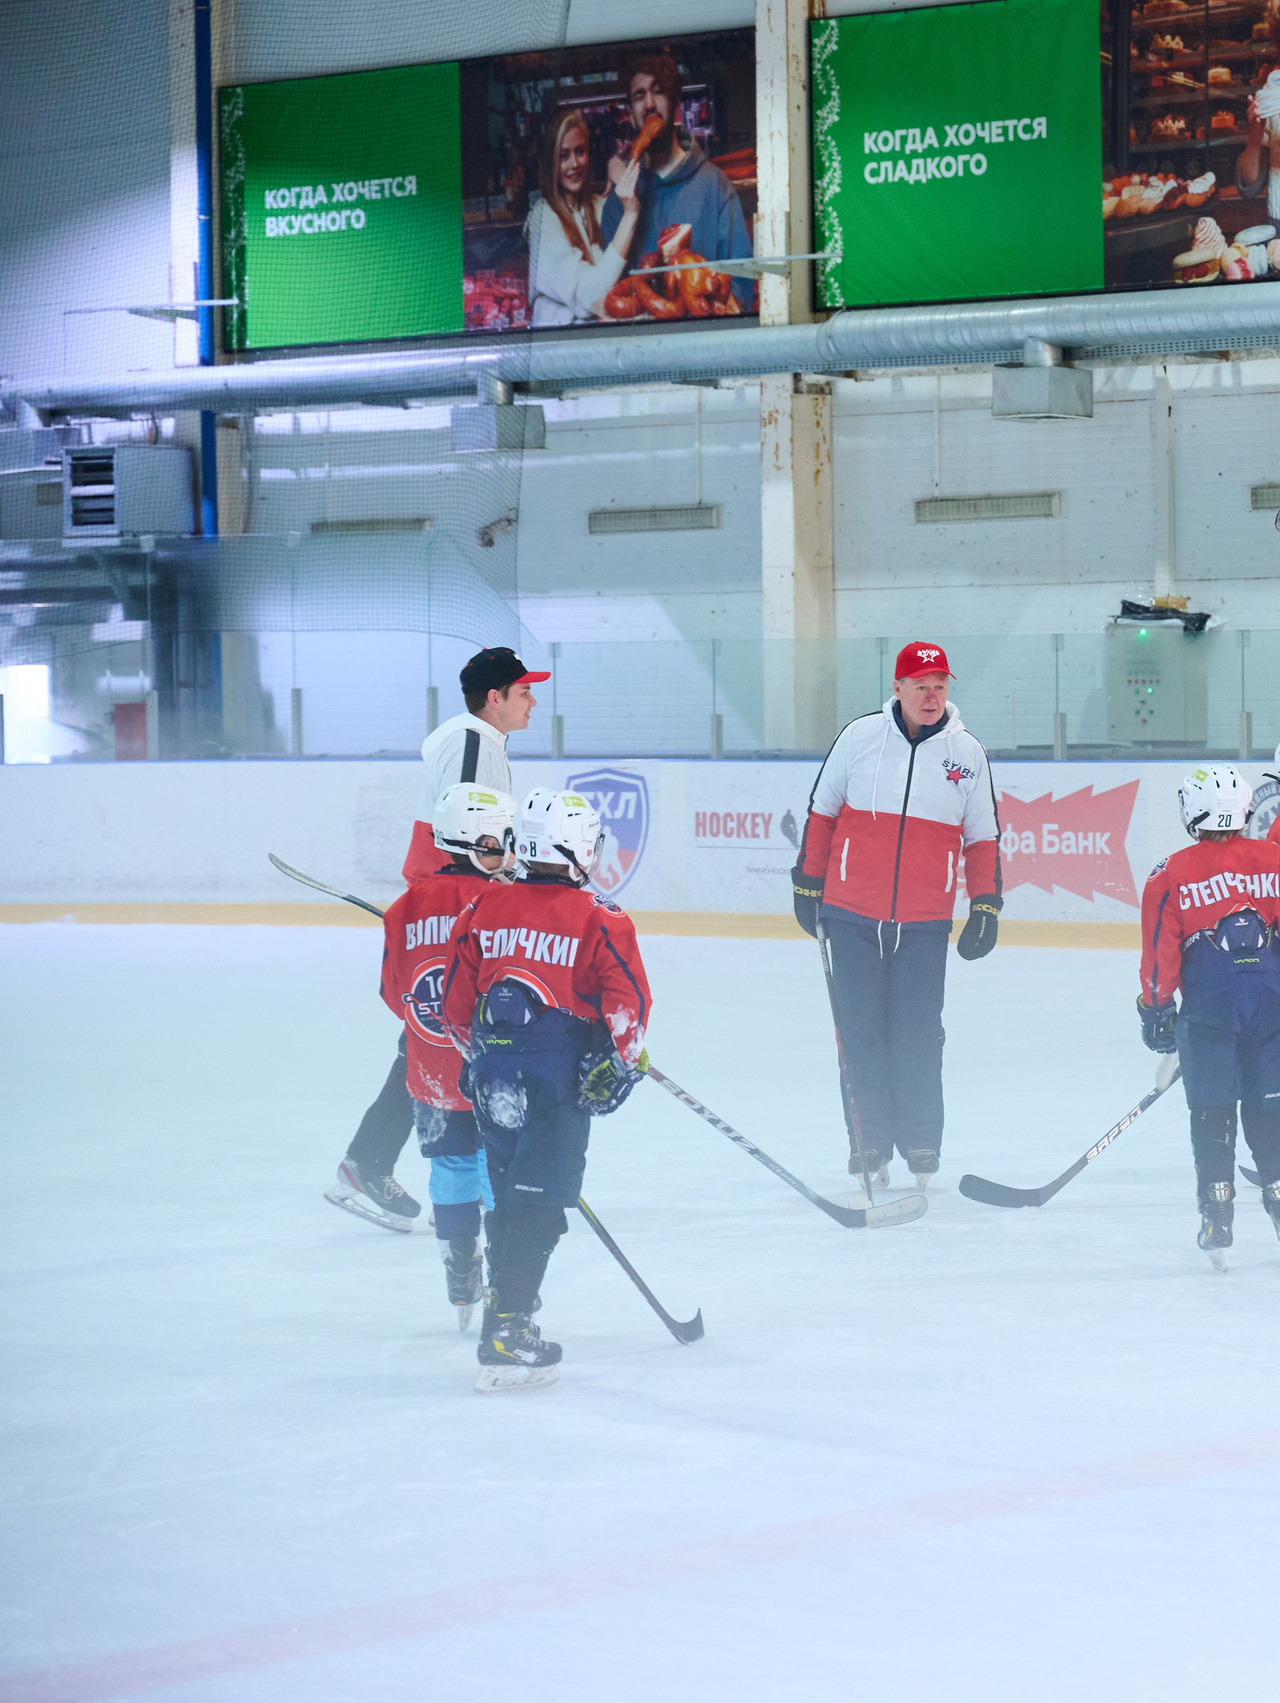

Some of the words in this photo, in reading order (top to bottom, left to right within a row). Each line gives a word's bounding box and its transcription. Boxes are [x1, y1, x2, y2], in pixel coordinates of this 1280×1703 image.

[863, 124, 938, 155] КОГДА
[943, 116, 1047, 147] ХОЧЕТСЯ
[863, 153, 988, 185] СЛАДКОГО
[265, 185, 328, 210] КОГДА
[331, 175, 418, 204] ХОЧЕТСЯ
[265, 208, 366, 237] ВКУСНОГО
[694, 811, 773, 839] HOCKEY
[1217, 814, 1232, 828] 20
[529, 841, 537, 857] 8
[999, 823, 1036, 862] фа
[1042, 823, 1112, 855] Банк
